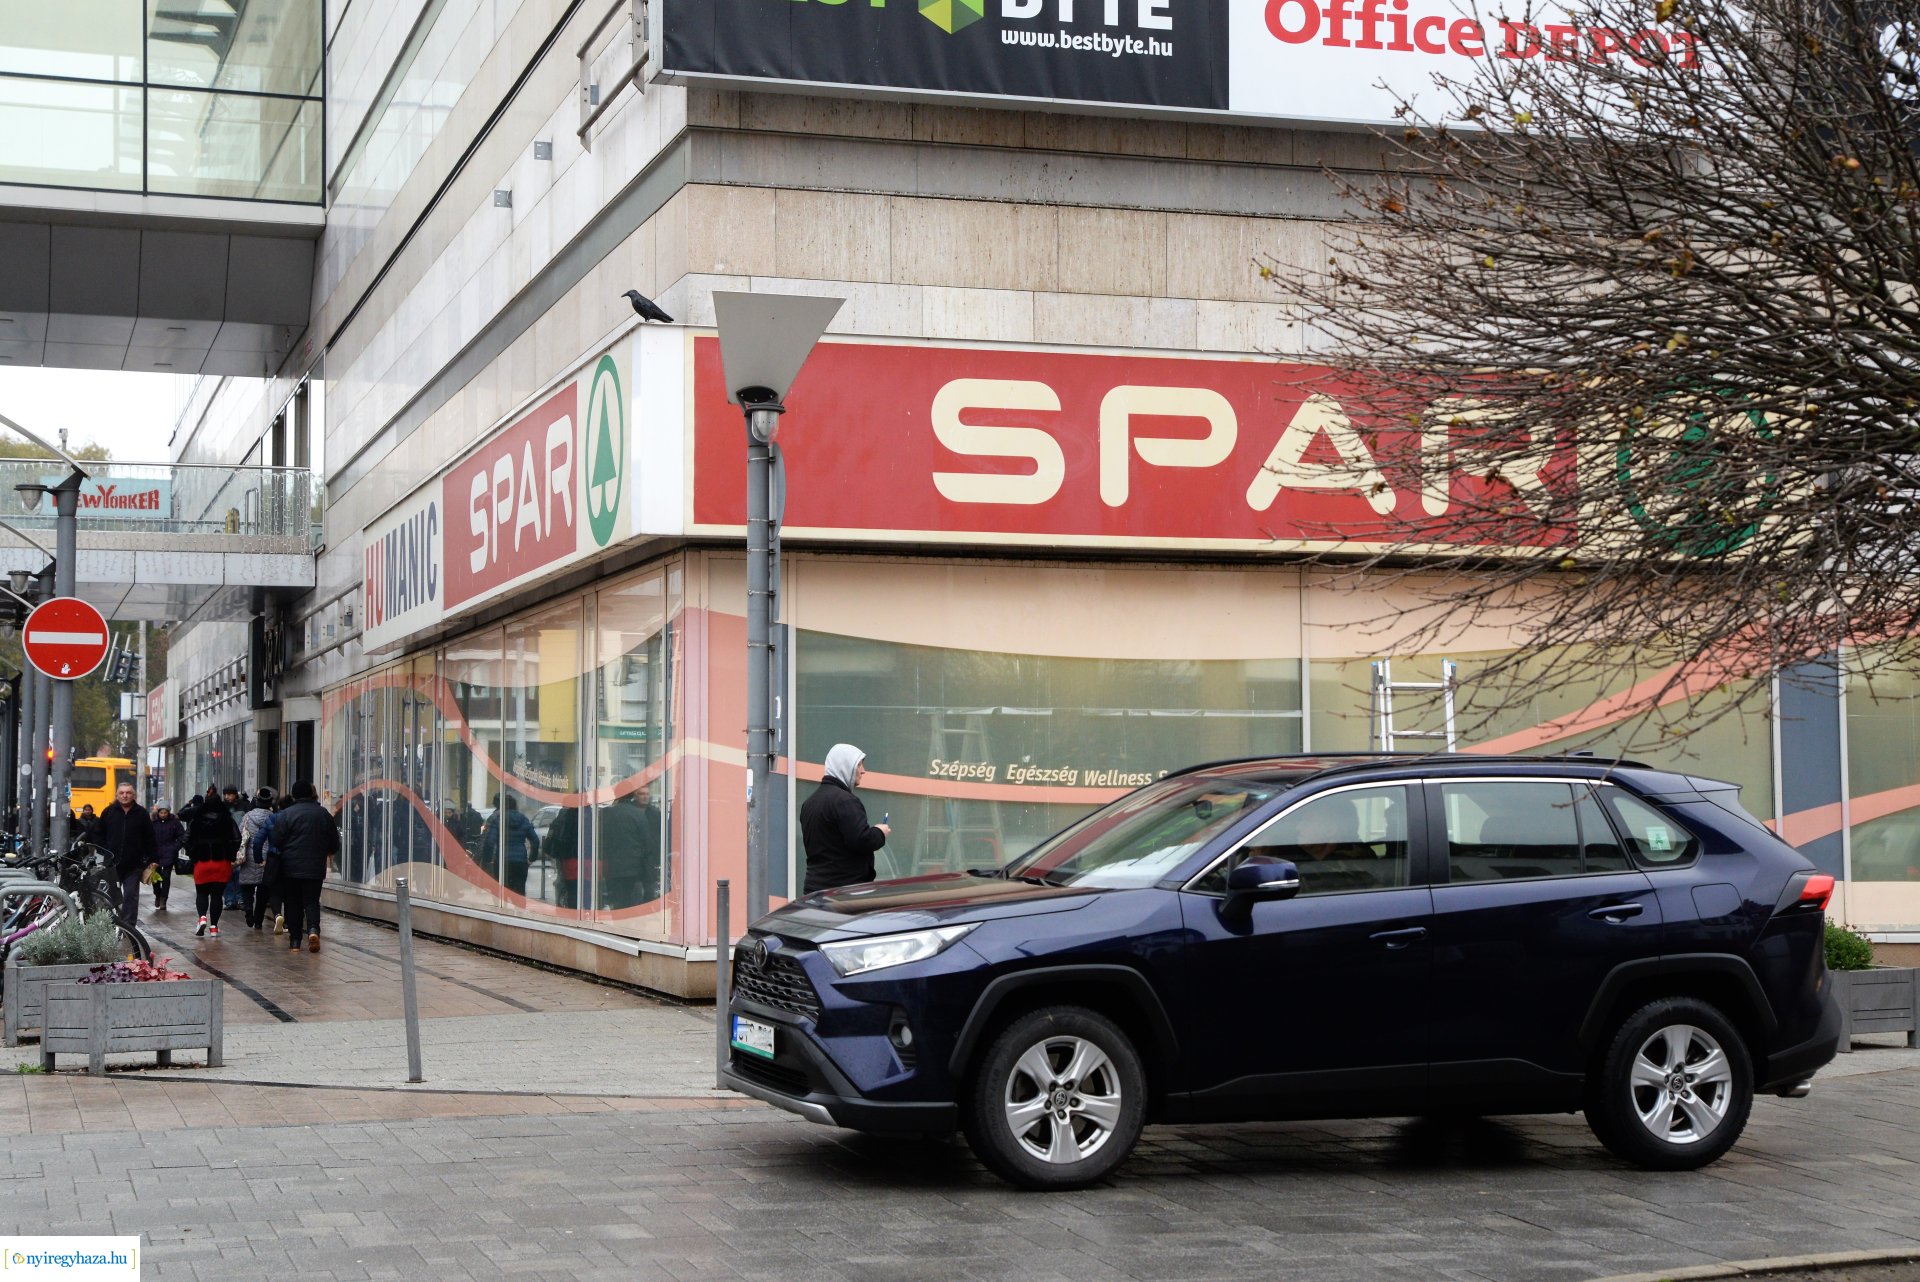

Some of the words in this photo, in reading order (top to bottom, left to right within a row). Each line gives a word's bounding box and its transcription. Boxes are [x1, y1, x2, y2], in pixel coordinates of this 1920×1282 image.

[1001, 29, 1172, 58] www.bestbyte.hu
[1264, 0, 1486, 57] Office
[1498, 21, 1707, 69] DEPOT
[931, 378, 1556, 517] SPAR
[52, 484, 159, 510] WYORKER
[470, 414, 573, 574] SPAR
[365, 501, 438, 632] HUMANIC
[929, 759, 996, 781] Szépség
[1006, 763, 1078, 785] Egészség
[1084, 769, 1152, 786] Wellness
